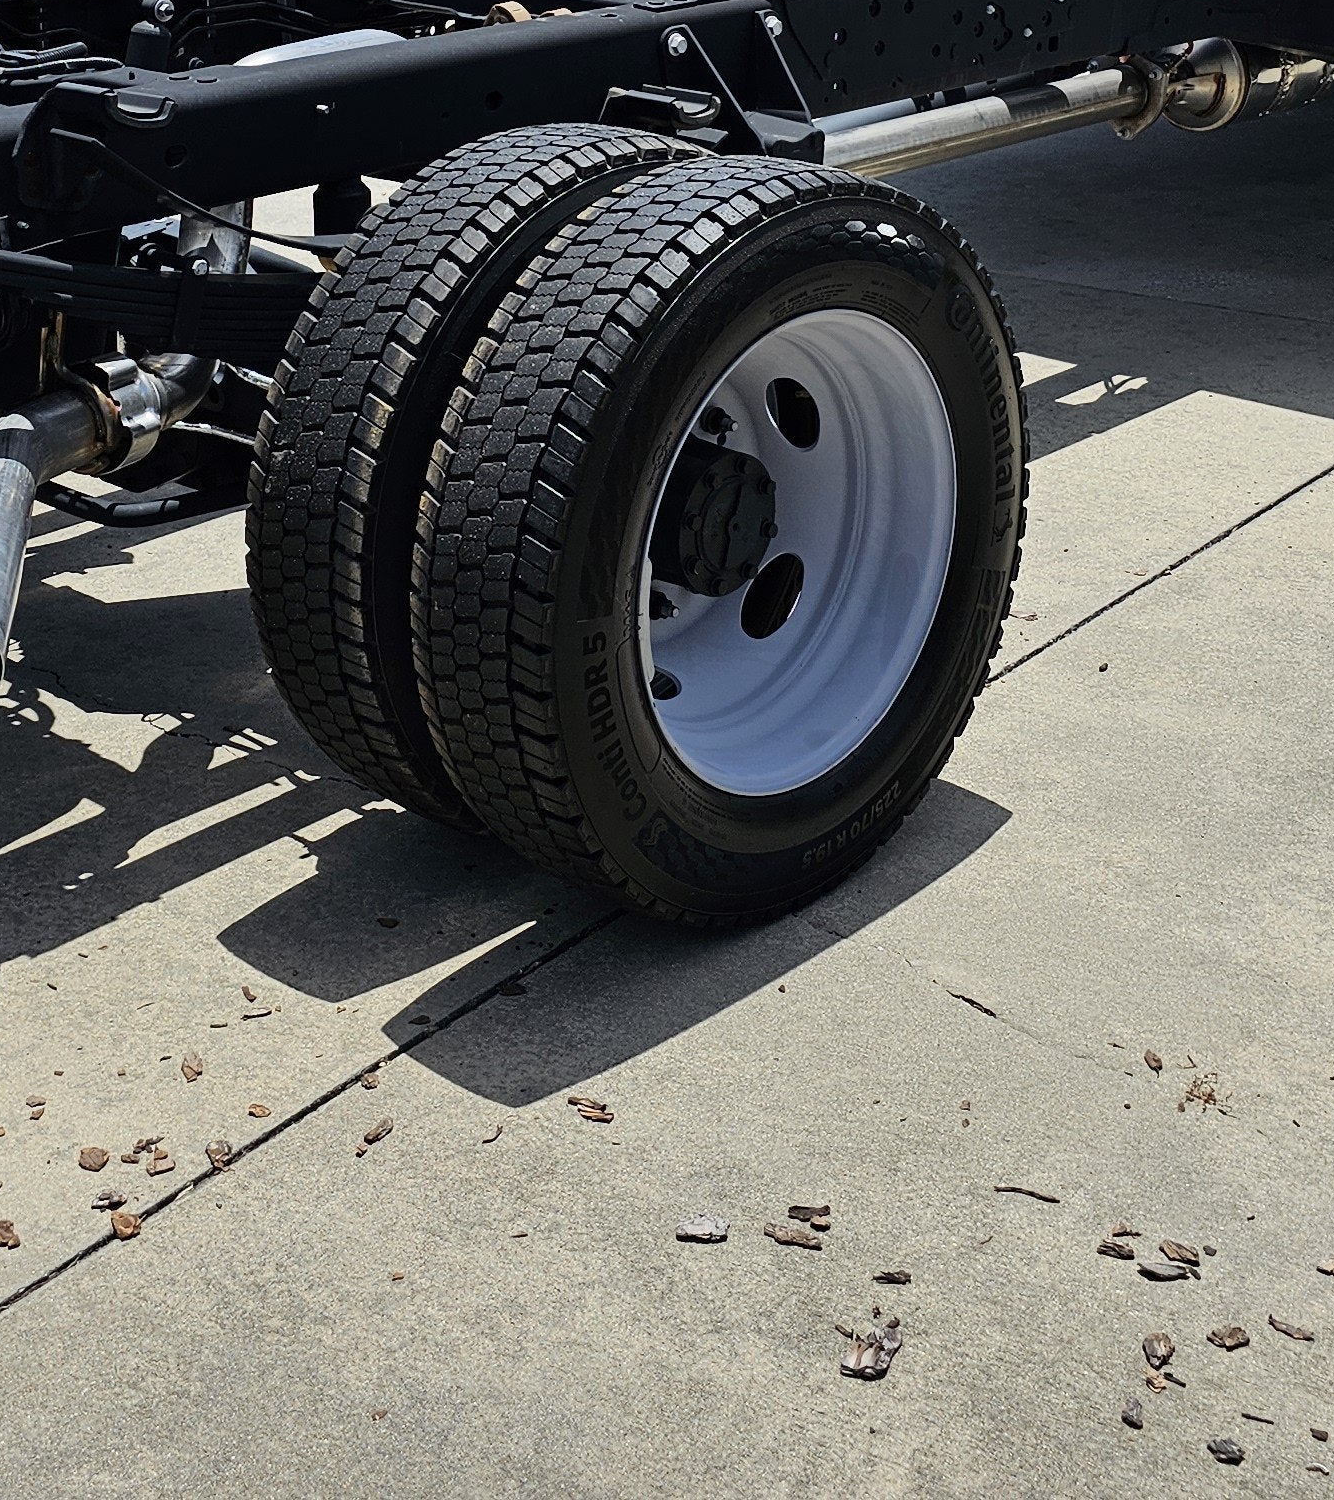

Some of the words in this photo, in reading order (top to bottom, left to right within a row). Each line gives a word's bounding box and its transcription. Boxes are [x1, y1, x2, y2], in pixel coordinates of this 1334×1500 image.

[946, 284, 1015, 507] Continental
[582, 631, 607, 656] 5
[584, 658, 617, 743] HDR
[597, 739, 647, 822] Conti
